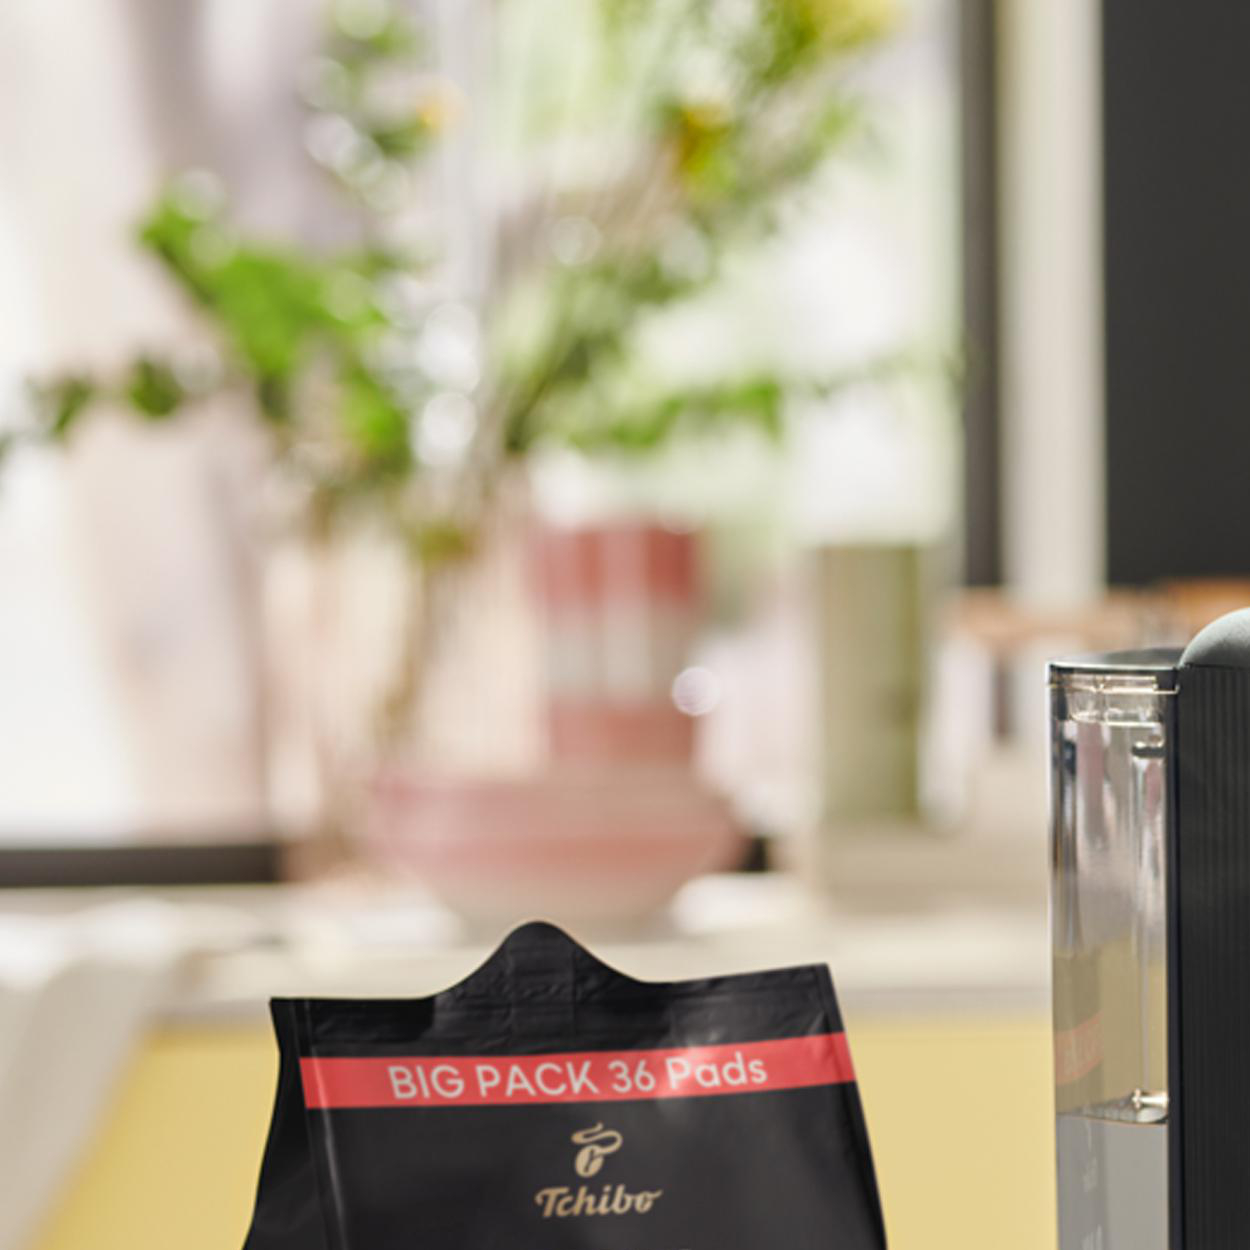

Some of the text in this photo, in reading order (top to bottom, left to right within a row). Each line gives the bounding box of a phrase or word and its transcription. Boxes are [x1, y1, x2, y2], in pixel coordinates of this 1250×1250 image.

[387, 1051, 768, 1100] BIG PACK 36 Pads
[534, 1184, 662, 1218] Tchibo
